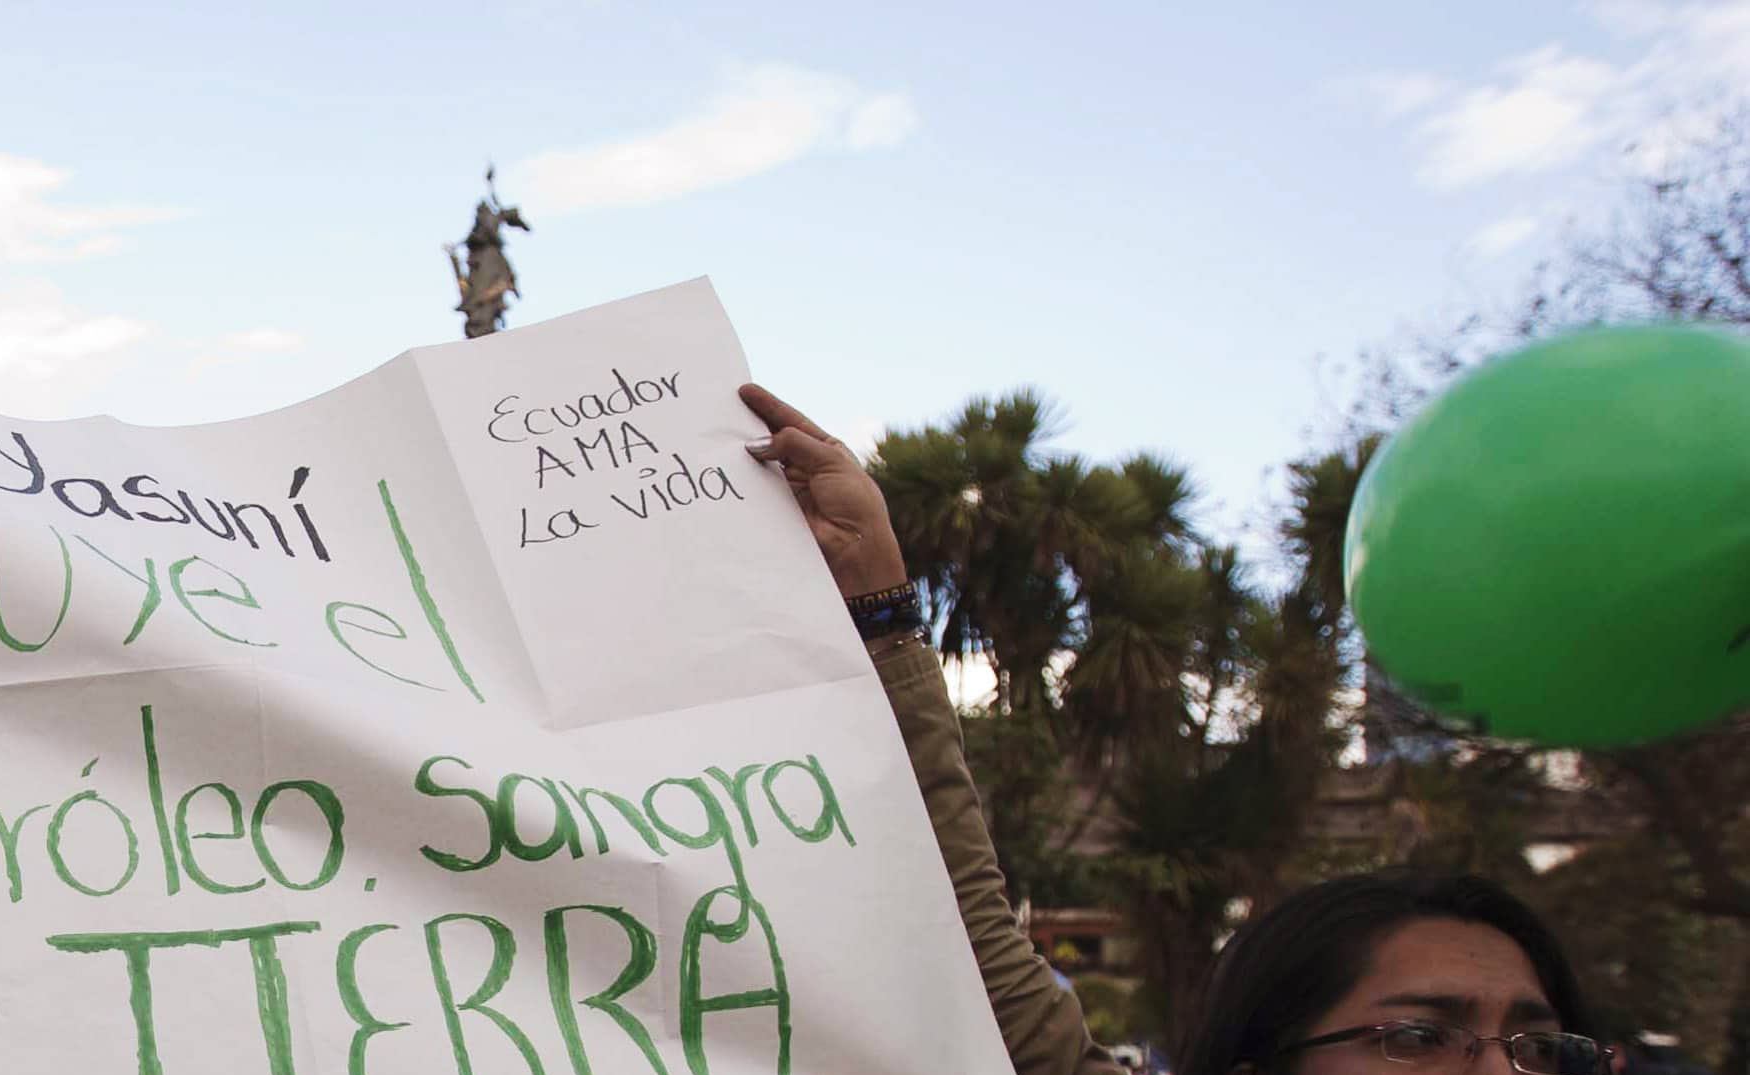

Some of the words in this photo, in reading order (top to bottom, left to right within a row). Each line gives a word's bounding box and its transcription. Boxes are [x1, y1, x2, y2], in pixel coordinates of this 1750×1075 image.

[487, 367, 680, 443] Ecuador
[534, 420, 660, 489] AMA
[519, 507, 600, 549] La
[325, 478, 486, 704] el
